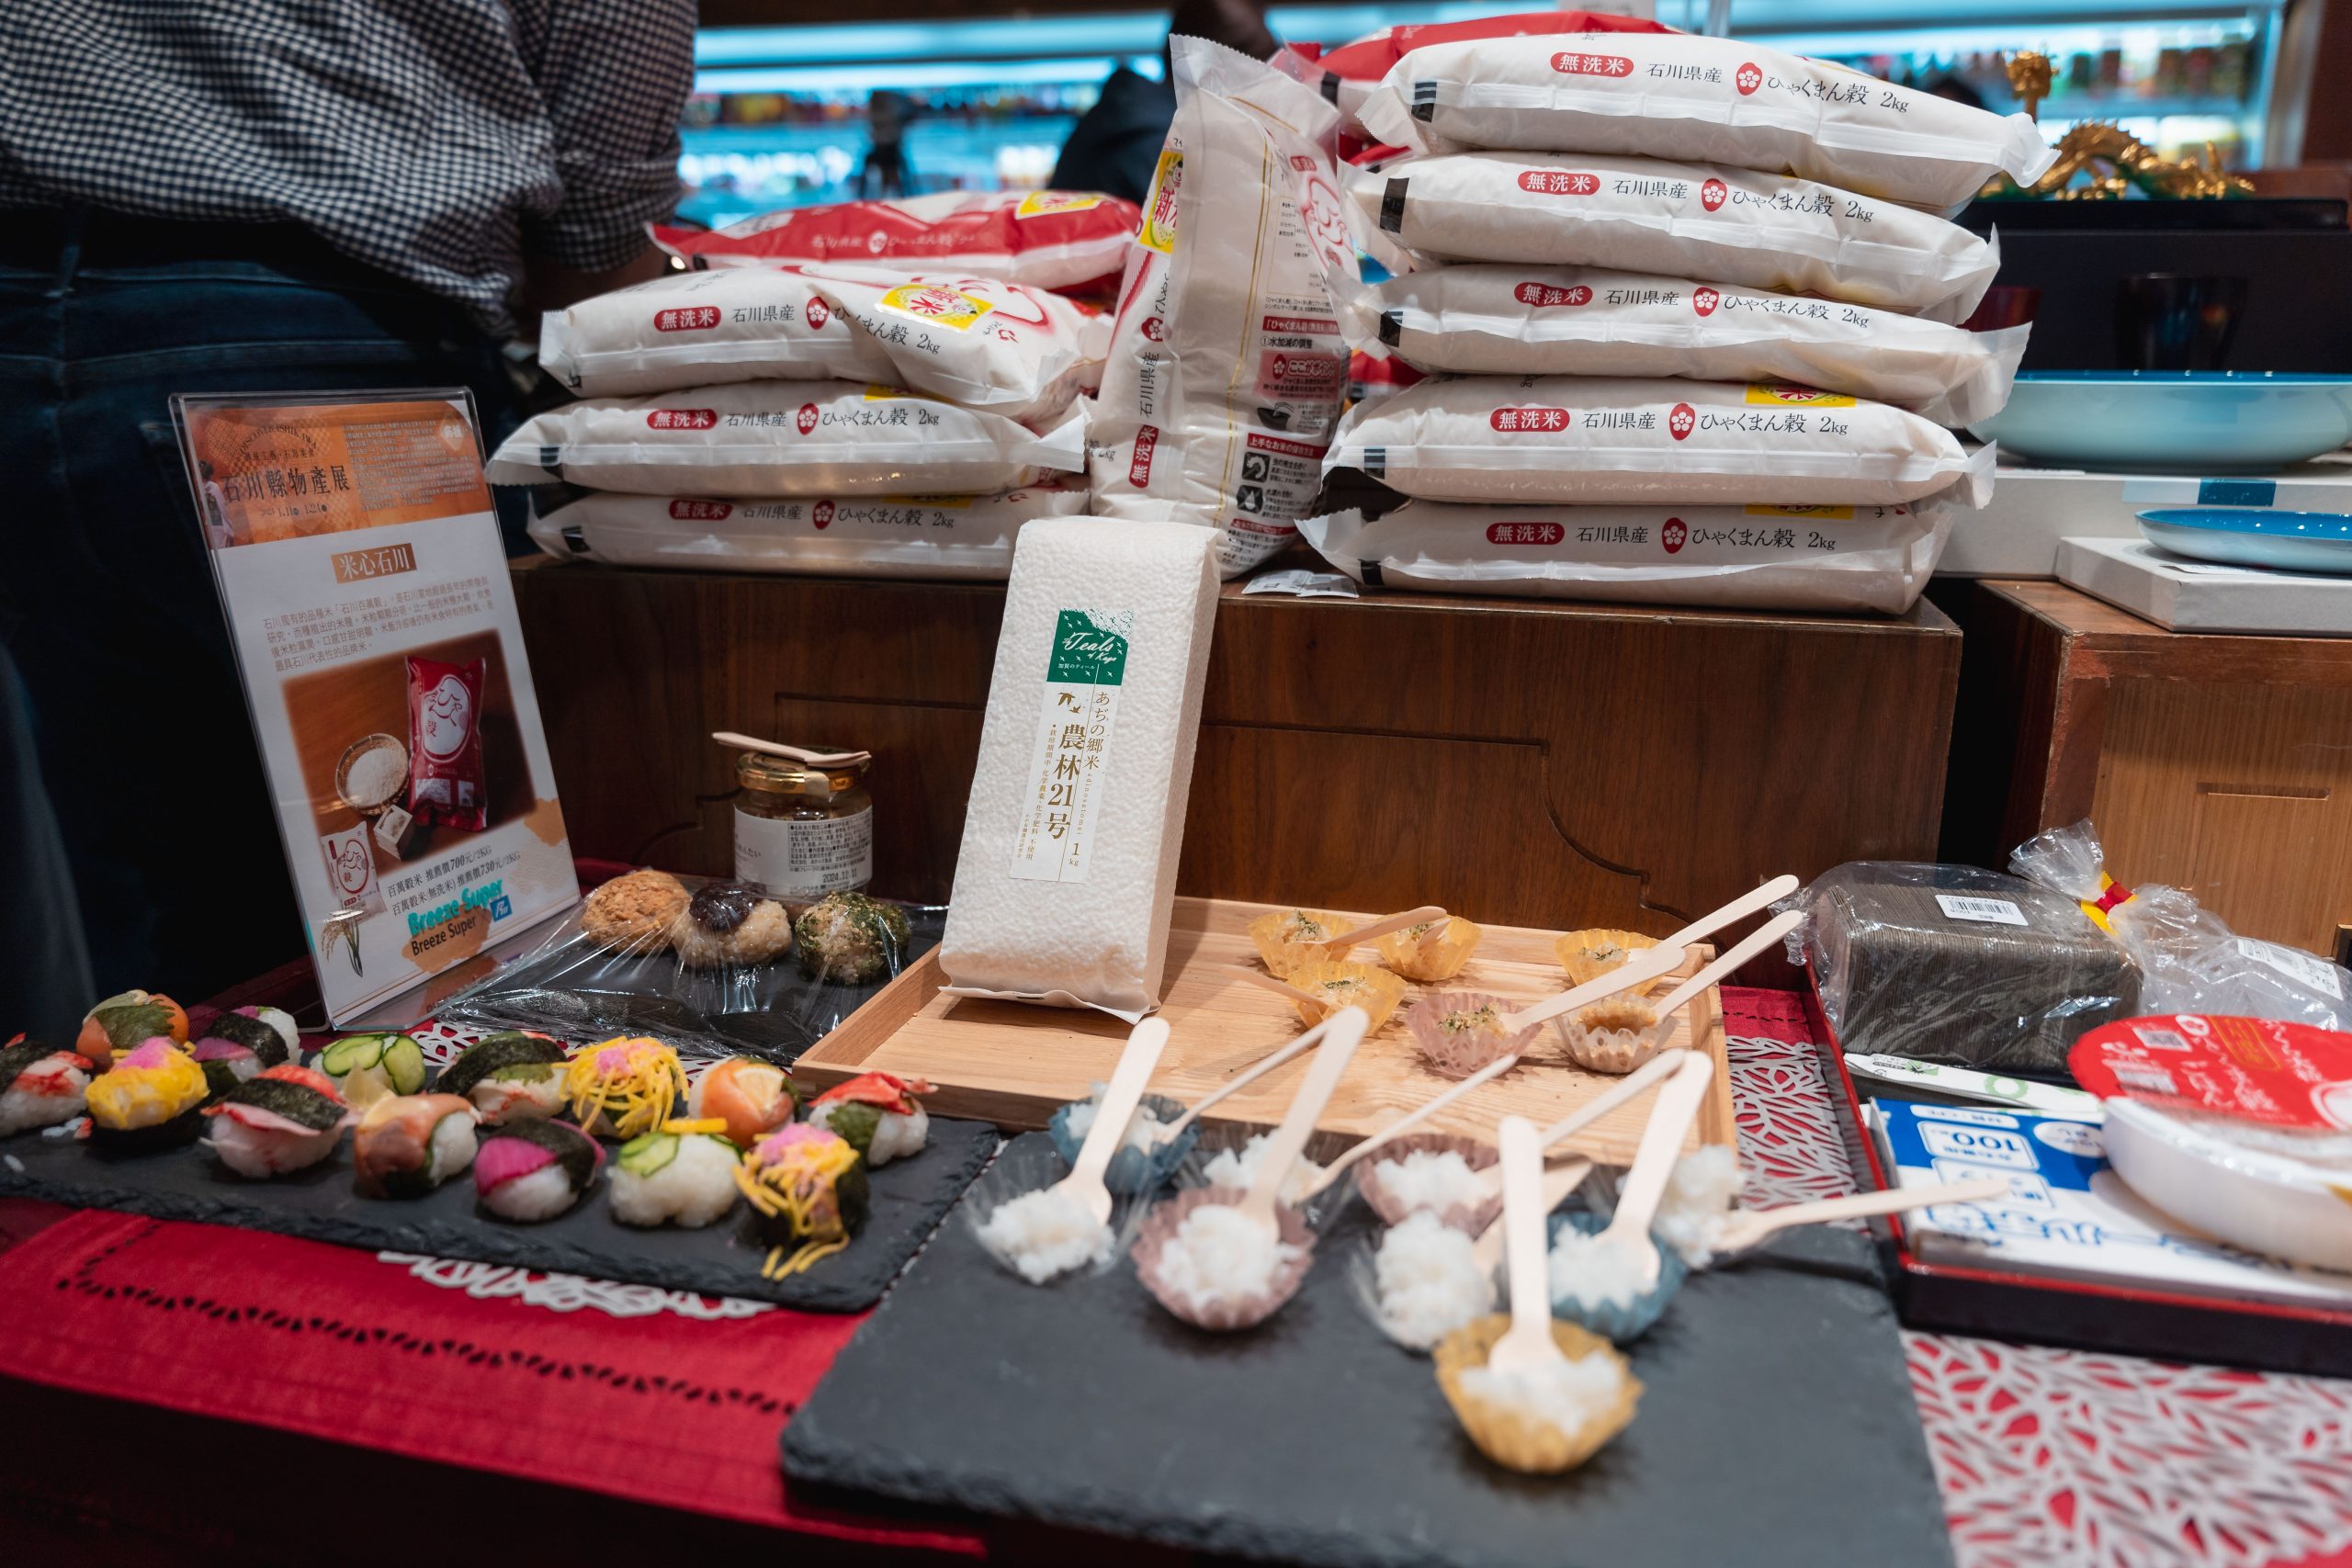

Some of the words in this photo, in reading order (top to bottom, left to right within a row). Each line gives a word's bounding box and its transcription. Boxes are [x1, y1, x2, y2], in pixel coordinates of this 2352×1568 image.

[1558, 53, 1625, 74] 無洗米
[1645, 62, 1723, 85] 石川県産
[1768, 75, 1870, 106] ひゃくまん穀
[1880, 90, 1910, 114] 2kg
[1526, 172, 1591, 193] 無洗米
[1613, 179, 1688, 199] 石川県産
[1732, 189, 1835, 218] ひゃくまん穀
[1844, 199, 1874, 223] 2kg
[661, 309, 716, 330] 無洗米
[732, 304, 795, 323] 石川県産
[916, 333, 942, 355] 2kg
[1522, 284, 1585, 305] 無洗米
[1605, 288, 1679, 307] 石川県産
[1724, 294, 1830, 321] ひゃくまん穀
[1841, 308, 1870, 330] 2kg
[1139, 350, 1159, 418] 石川県産
[654, 412, 709, 428] 無洗米
[726, 412, 787, 428] 石川県産
[822, 408, 908, 426] ひゃくまん穀
[918, 409, 939, 427] 2kg
[1498, 410, 1562, 430] 無洗米
[1581, 411, 1656, 430] 石川県産
[1700, 412, 1806, 434] ひゃくまん穀
[1818, 415, 1849, 436] 2kg
[1132, 425, 1156, 483] 無洗米
[220, 464, 351, 503] 石川縣物產展
[674, 501, 725, 518] 無洗米
[741, 504, 802, 521] 石川県産
[837, 506, 922, 527] ひゃくまん穀
[932, 511, 955, 529] 2kg
[1494, 524, 1556, 543] 無洗米
[1575, 526, 1649, 545] 石川県産
[1691, 527, 1795, 549] ひゃくまん穀
[1806, 531, 1836, 551] 2kg
[337, 546, 412, 581] 米心石川
[1064, 632, 1115, 650] Teals
[1084, 692, 1110, 771] あぢの郷米
[1044, 723, 1087, 840] 農林21号
[407, 899, 461, 937] Breeze
[461, 878, 503, 911] Super
[411, 931, 447, 956] Breeze
[447, 916, 477, 938] Super
